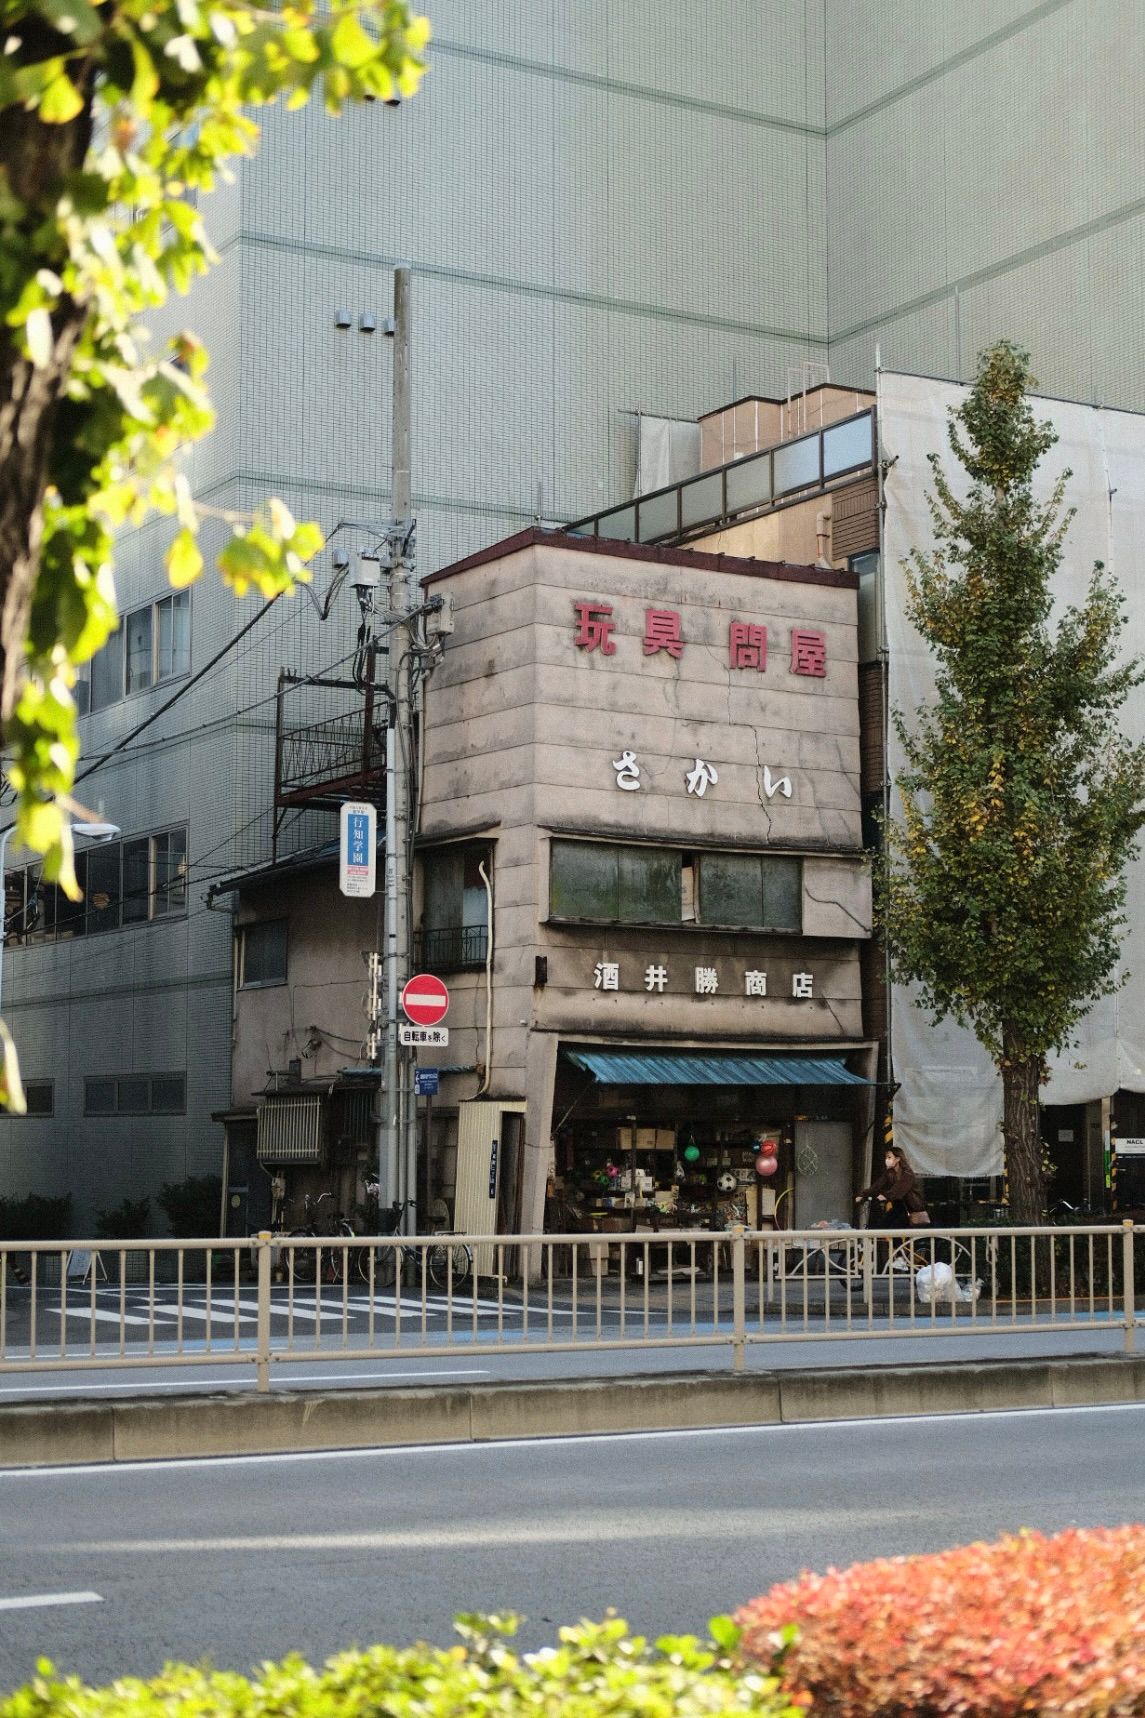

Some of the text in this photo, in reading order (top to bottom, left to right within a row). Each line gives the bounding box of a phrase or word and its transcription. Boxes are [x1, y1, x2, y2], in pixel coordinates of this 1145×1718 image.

[574, 602, 827, 678] 玩具問屋
[613, 750, 792, 799] さかい
[353, 816, 364, 864] 行知学園
[594, 962, 814, 1000] 酒井勝商店
[404, 1030, 446, 1043] 自転車を除く
